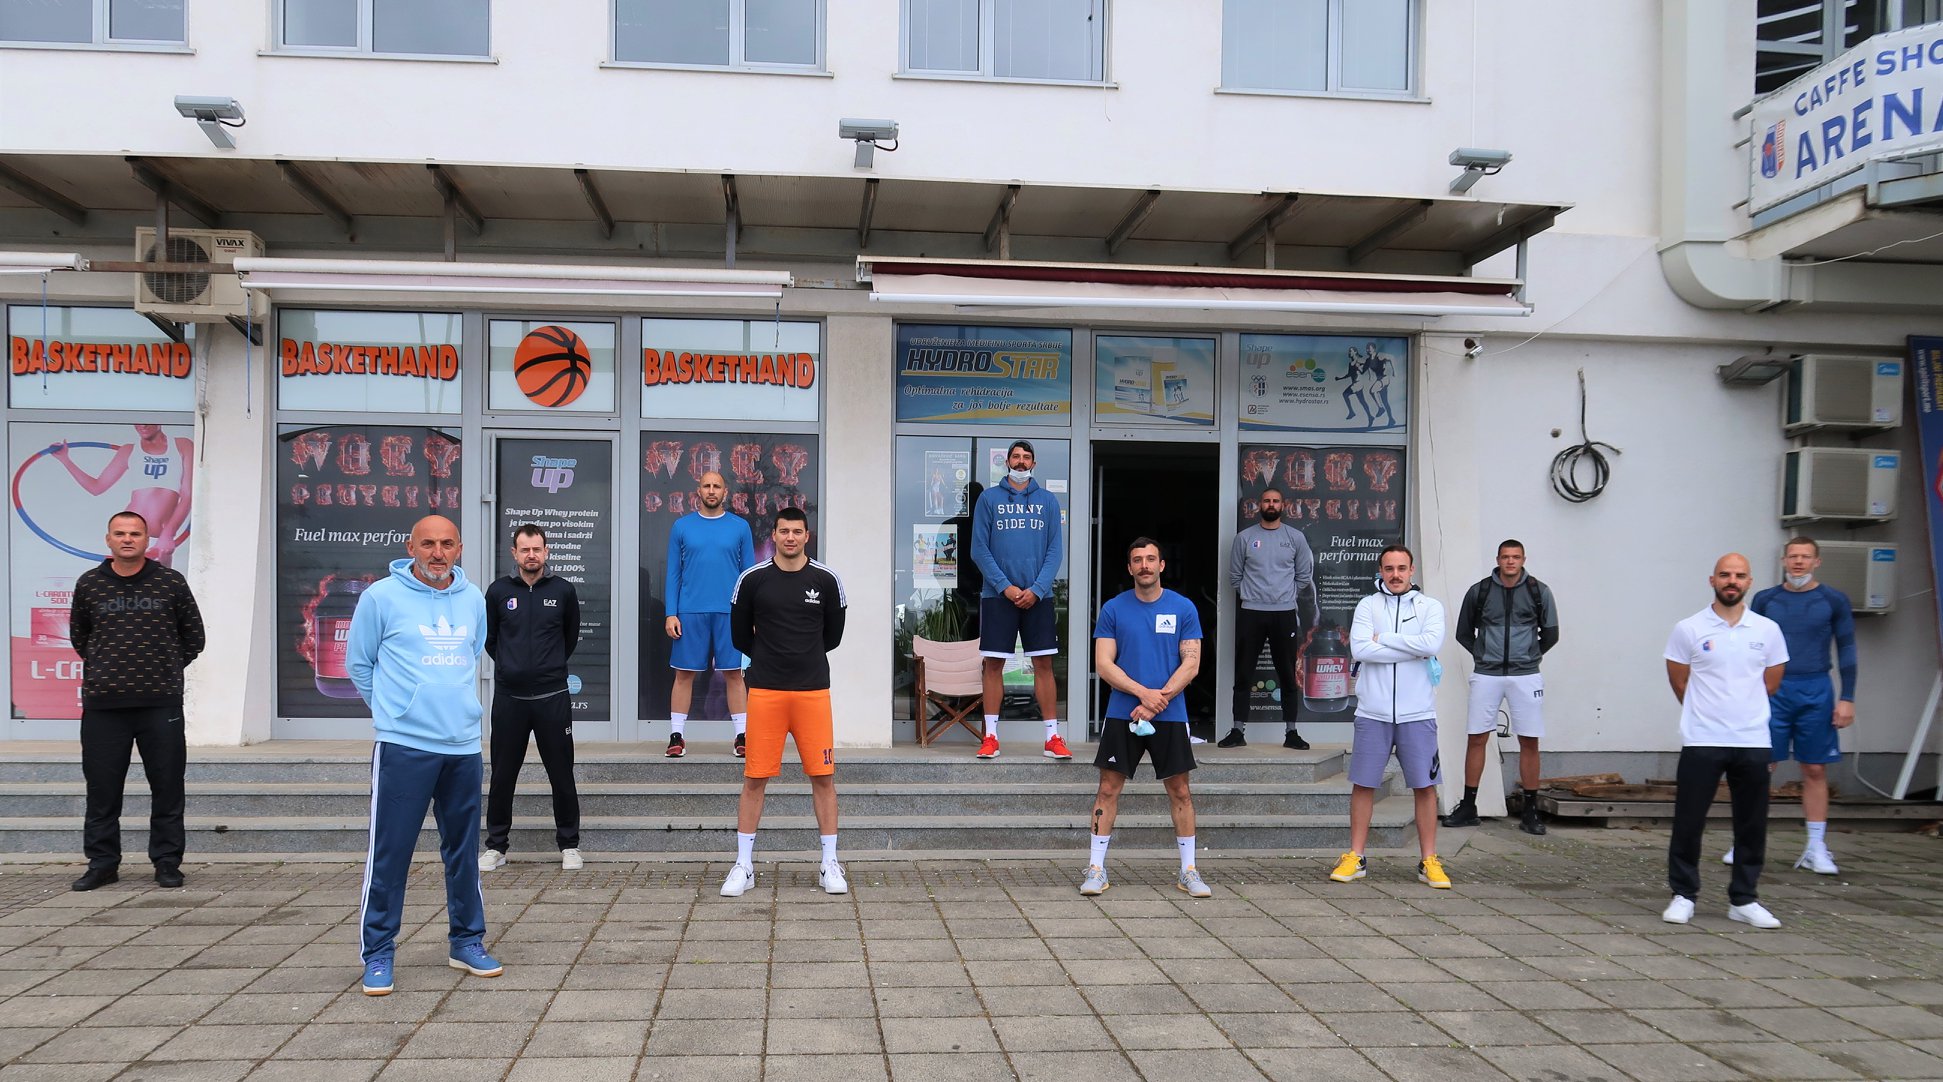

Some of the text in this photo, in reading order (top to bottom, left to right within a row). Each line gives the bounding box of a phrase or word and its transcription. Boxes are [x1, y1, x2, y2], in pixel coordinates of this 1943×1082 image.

[1795, 58, 1866, 117] CAFFE
[1008, 340, 1037, 349] SPORTA
[12, 336, 191, 379] BASKETHAND
[282, 338, 458, 381] BASKETHAND
[644, 348, 815, 389] BASKETHAND
[904, 384, 1014, 398] Optimalna rehidracija
[952, 400, 1059, 412] za još bolje rezultate
[144, 456, 169, 464] Shape
[531, 455, 577, 469] Shape
[505, 508, 599, 518] Shape Up Whey protein
[997, 504, 1043, 515] SUNNY
[509, 519, 517, 527] je
[562, 520, 594, 528] visokim
[996, 518, 1045, 530] SIDE UP
[294, 528, 325, 542] Fuel
[328, 532, 361, 542] max
[1331, 536, 1384, 548] Fuel max
[549, 552, 581, 560] kiseline
[554, 564, 562, 572] iz
[562, 564, 585, 572] 100%
[97, 596, 163, 613] adidas
[421, 653, 467, 666] adidas
[1317, 664, 1344, 673] WHEY
